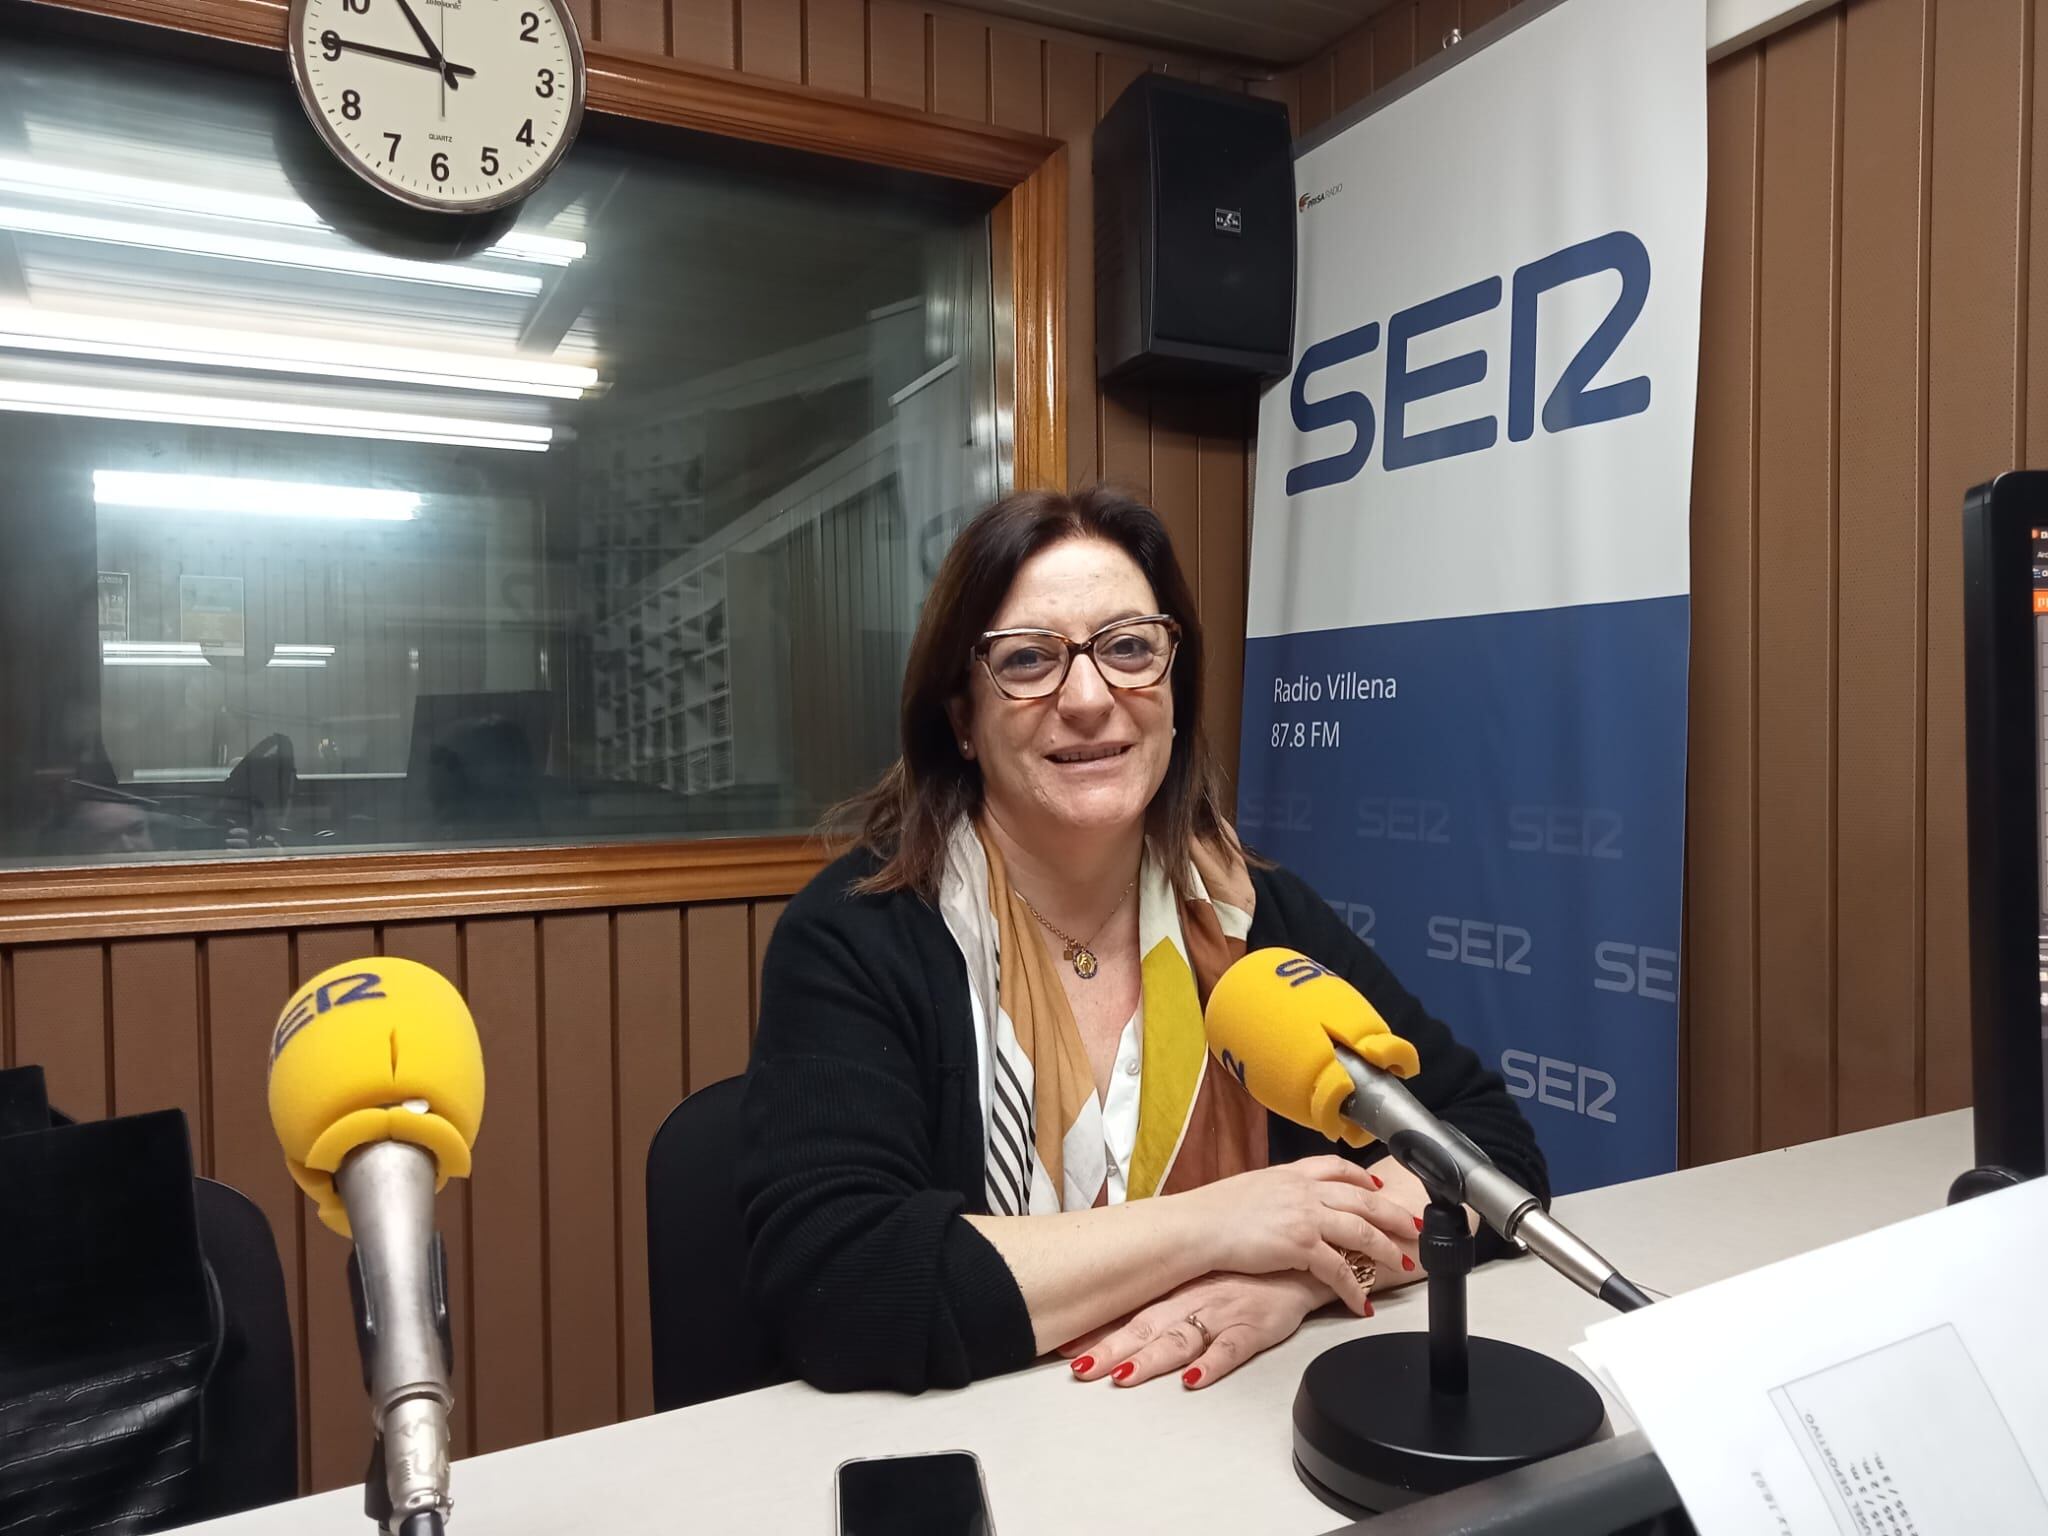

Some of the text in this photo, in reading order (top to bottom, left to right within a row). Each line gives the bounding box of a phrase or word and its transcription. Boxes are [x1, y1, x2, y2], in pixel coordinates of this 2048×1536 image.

[520, 12, 540, 43] 2
[321, 30, 342, 61] 9
[535, 69, 555, 98] 3
[341, 89, 361, 120] 8
[383, 132, 402, 162] 7
[428, 133, 453, 143] QUARTZ
[516, 119, 535, 147] 4
[430, 153, 450, 181] 6
[481, 147, 499, 176] 5
[1286, 231, 1651, 497] SER
[1274, 671, 1397, 703] Radio Villena
[1271, 721, 1340, 747] 87.8 FM
[1356, 799, 1450, 843] SER
[1508, 805, 1624, 859] SER
[1427, 915, 1532, 975] SER
[1501, 1049, 1617, 1123] SER
[1804, 1413, 1853, 1497] DEPORTIVO
